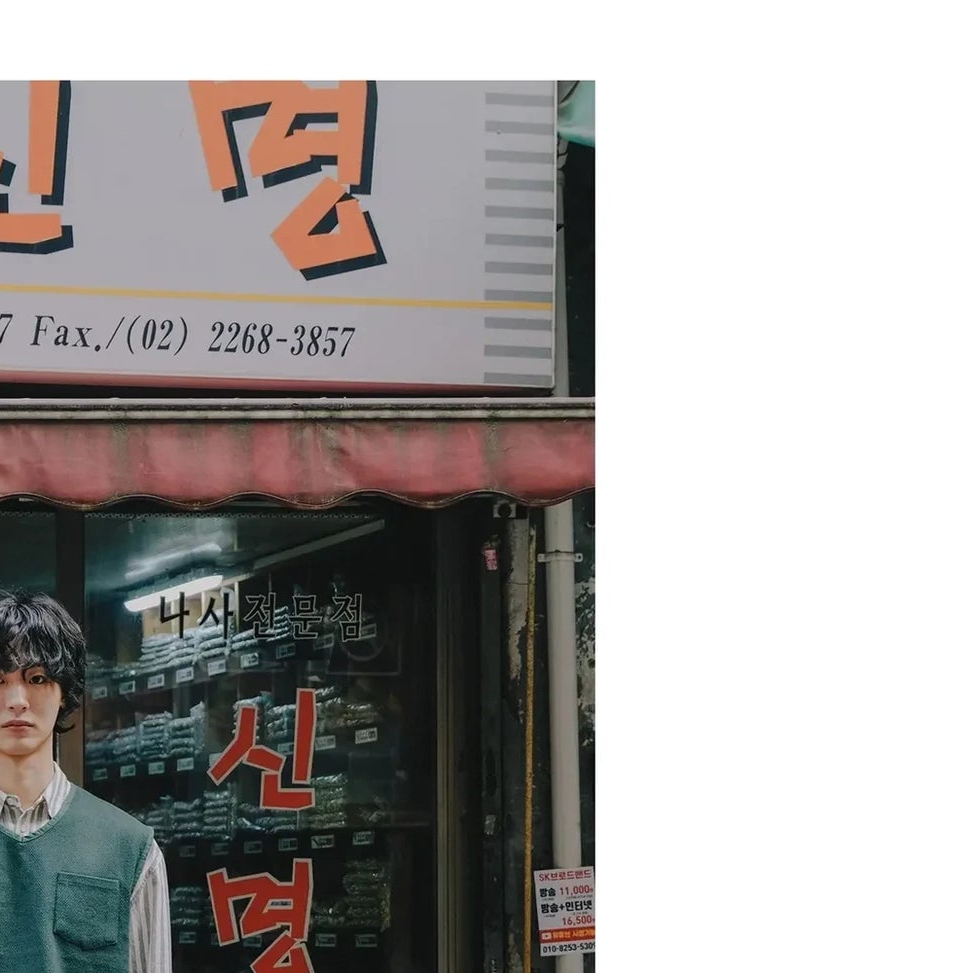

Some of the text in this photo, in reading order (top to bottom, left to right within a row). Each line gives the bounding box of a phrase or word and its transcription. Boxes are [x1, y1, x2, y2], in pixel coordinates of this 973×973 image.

[30, 314, 189, 356] Fax./(02)
[207, 320, 356, 358] 2268-3857
[160, 592, 362, 642] 나사전문점
